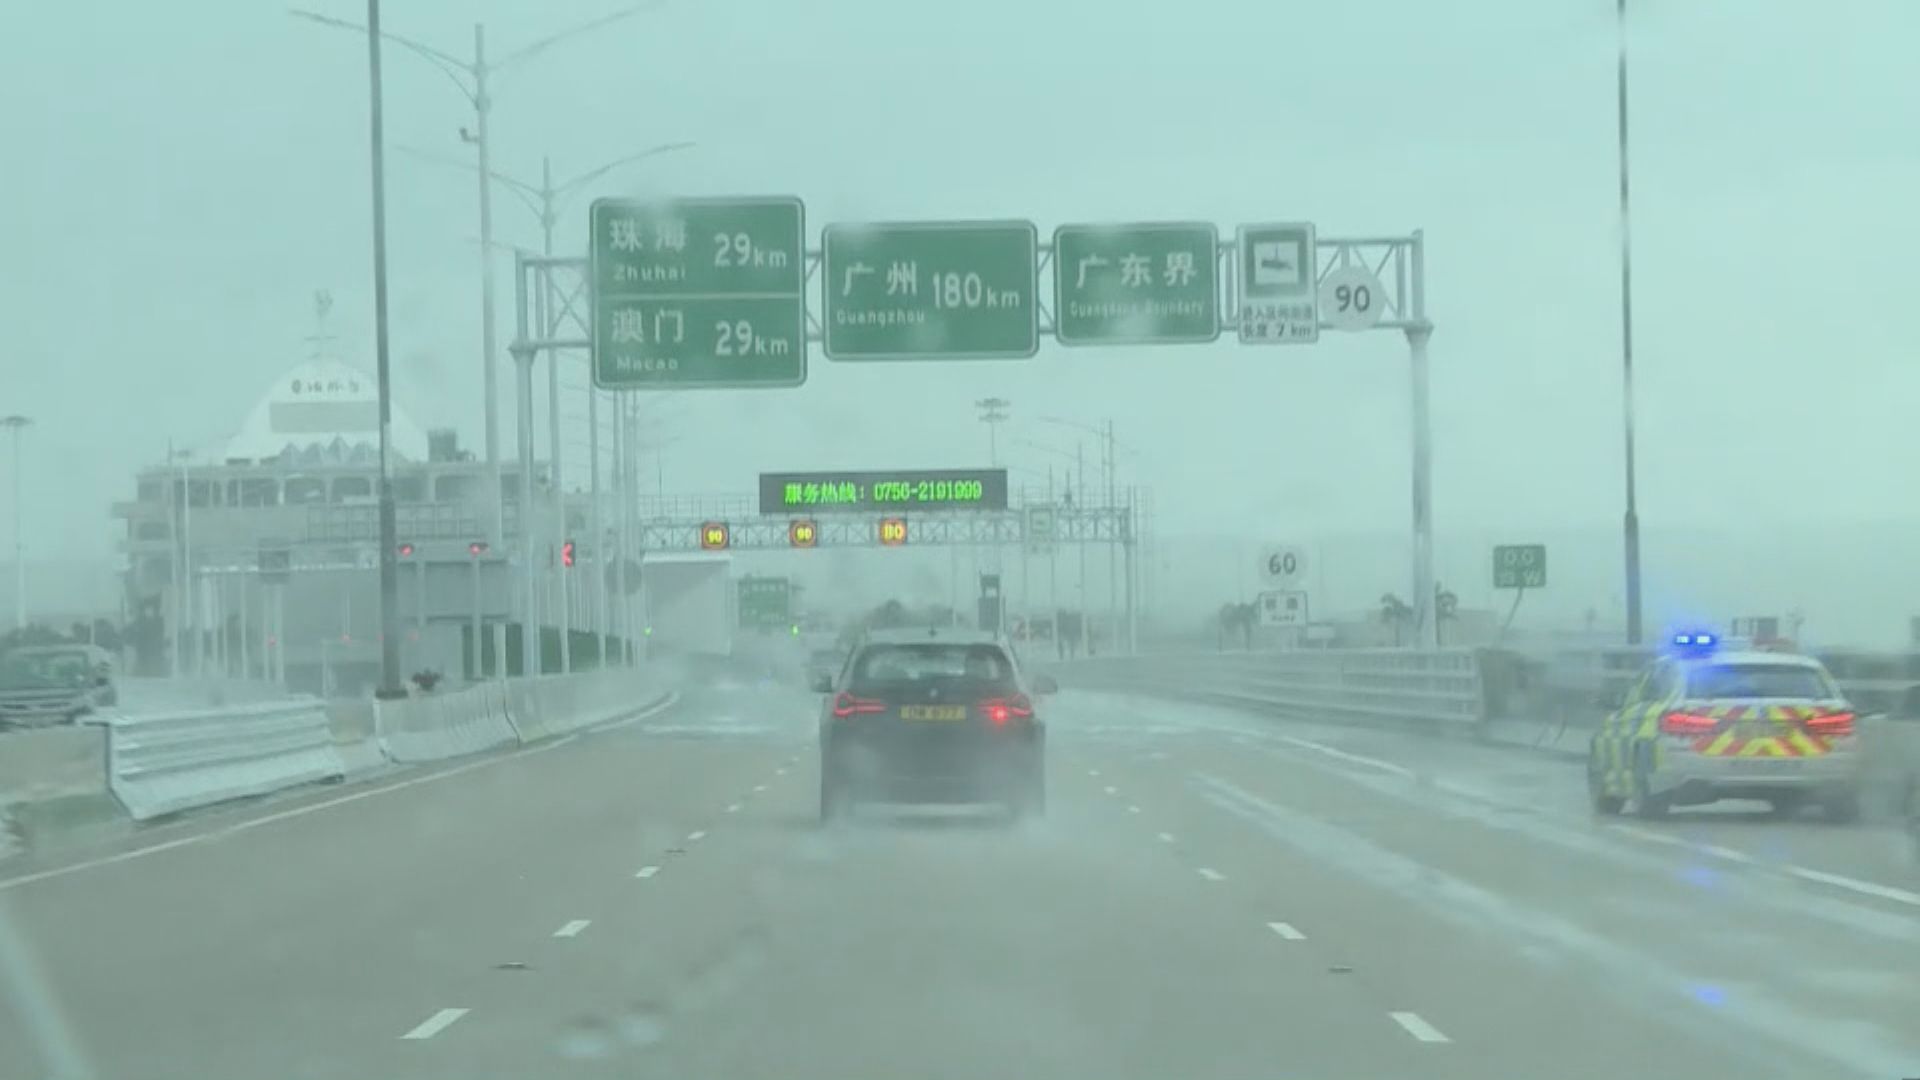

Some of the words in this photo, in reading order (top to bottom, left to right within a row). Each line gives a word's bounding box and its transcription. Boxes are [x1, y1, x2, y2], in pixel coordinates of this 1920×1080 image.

[608, 216, 688, 252] 珠海
[713, 232, 751, 268] 29
[754, 246, 788, 268] km
[614, 263, 686, 281] Zhuhai
[842, 260, 918, 297] 广州
[1076, 252, 1198, 289] 广东界
[932, 271, 982, 309] 180
[986, 287, 1021, 308] km
[1335, 284, 1371, 313] 90
[611, 308, 685, 344] 澳门
[836, 308, 926, 328] Guangzhou
[715, 320, 752, 356] 29
[754, 335, 789, 356] km
[616, 355, 679, 371] Macao
[1268, 552, 1297, 576] 60
